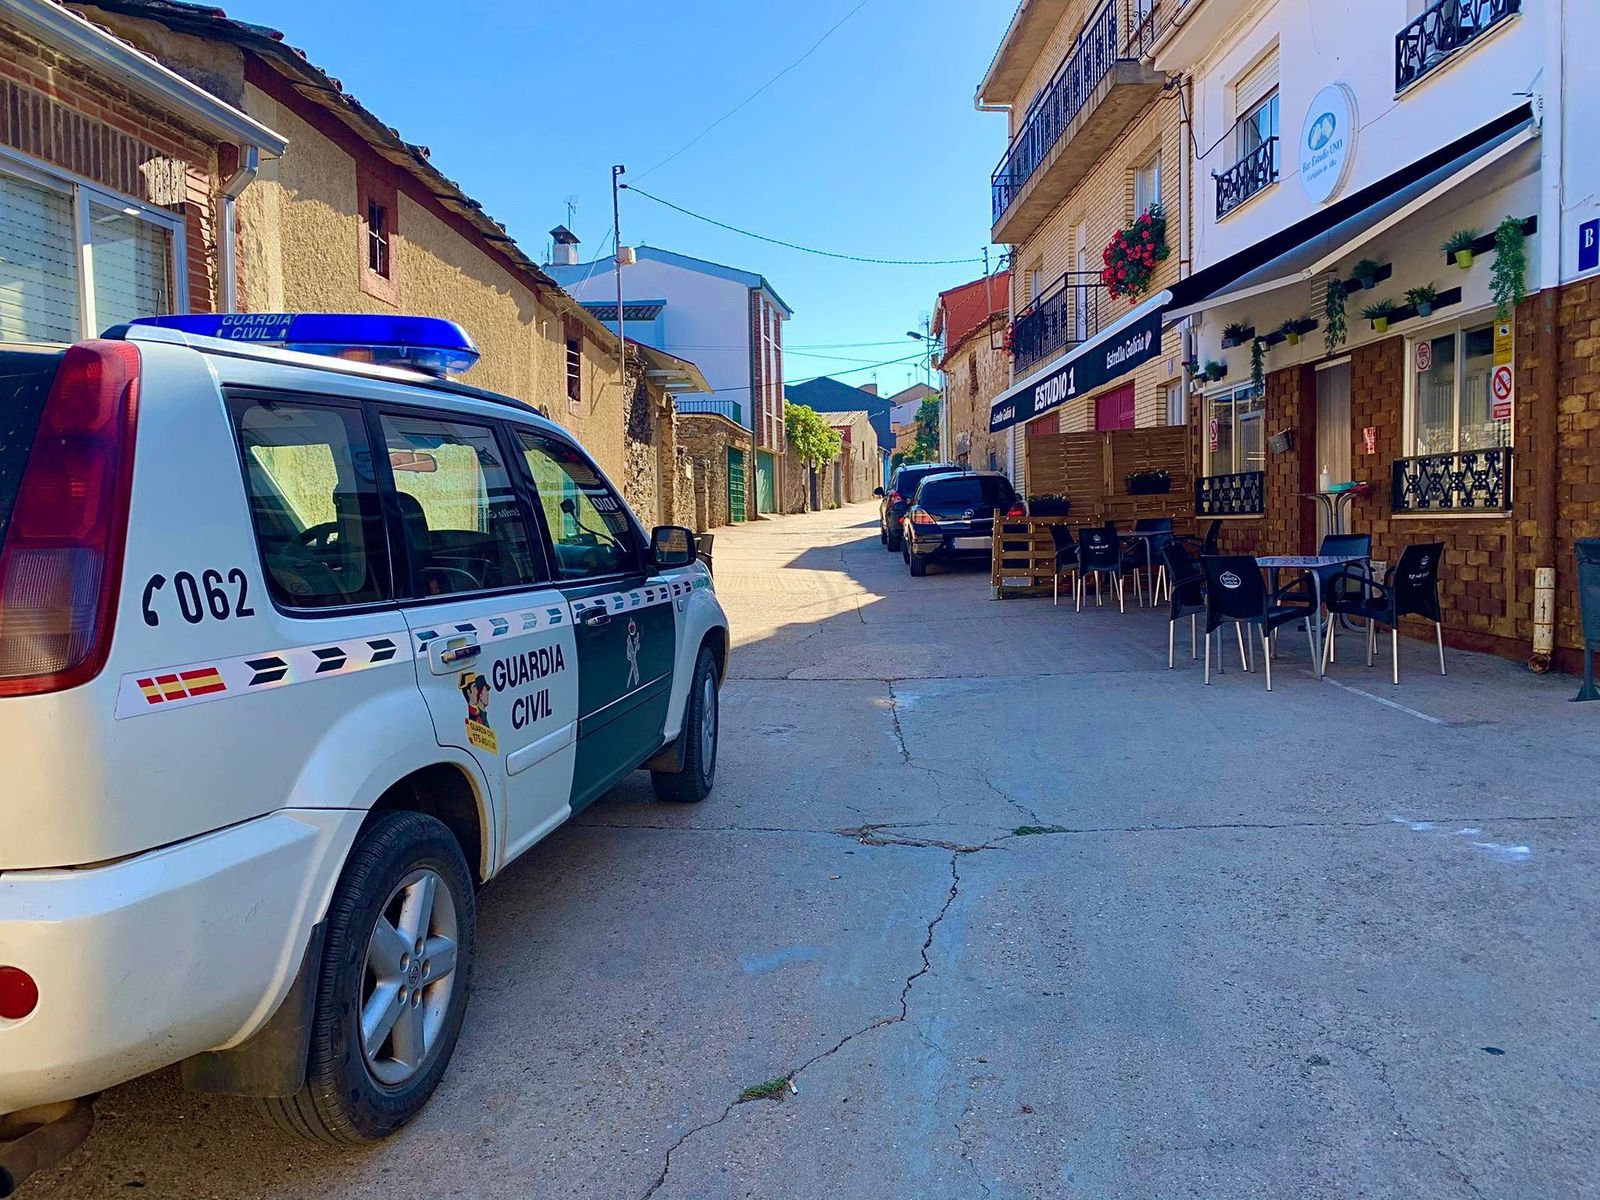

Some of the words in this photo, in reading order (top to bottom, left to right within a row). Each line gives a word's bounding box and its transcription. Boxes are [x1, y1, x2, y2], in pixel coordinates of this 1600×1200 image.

[1585, 228, 1594, 248] B
[221, 315, 292, 326] GUARDIA
[230, 327, 271, 339] CIVIL
[1106, 345, 1126, 370] Estrella
[1125, 333, 1144, 359] Galicia
[1034, 371, 1067, 411] ESTUDIO
[1067, 366, 1076, 396] 1
[174, 567, 255, 624] 062
[492, 643, 566, 693] GUARDIA
[511, 688, 553, 730] CIVIL
